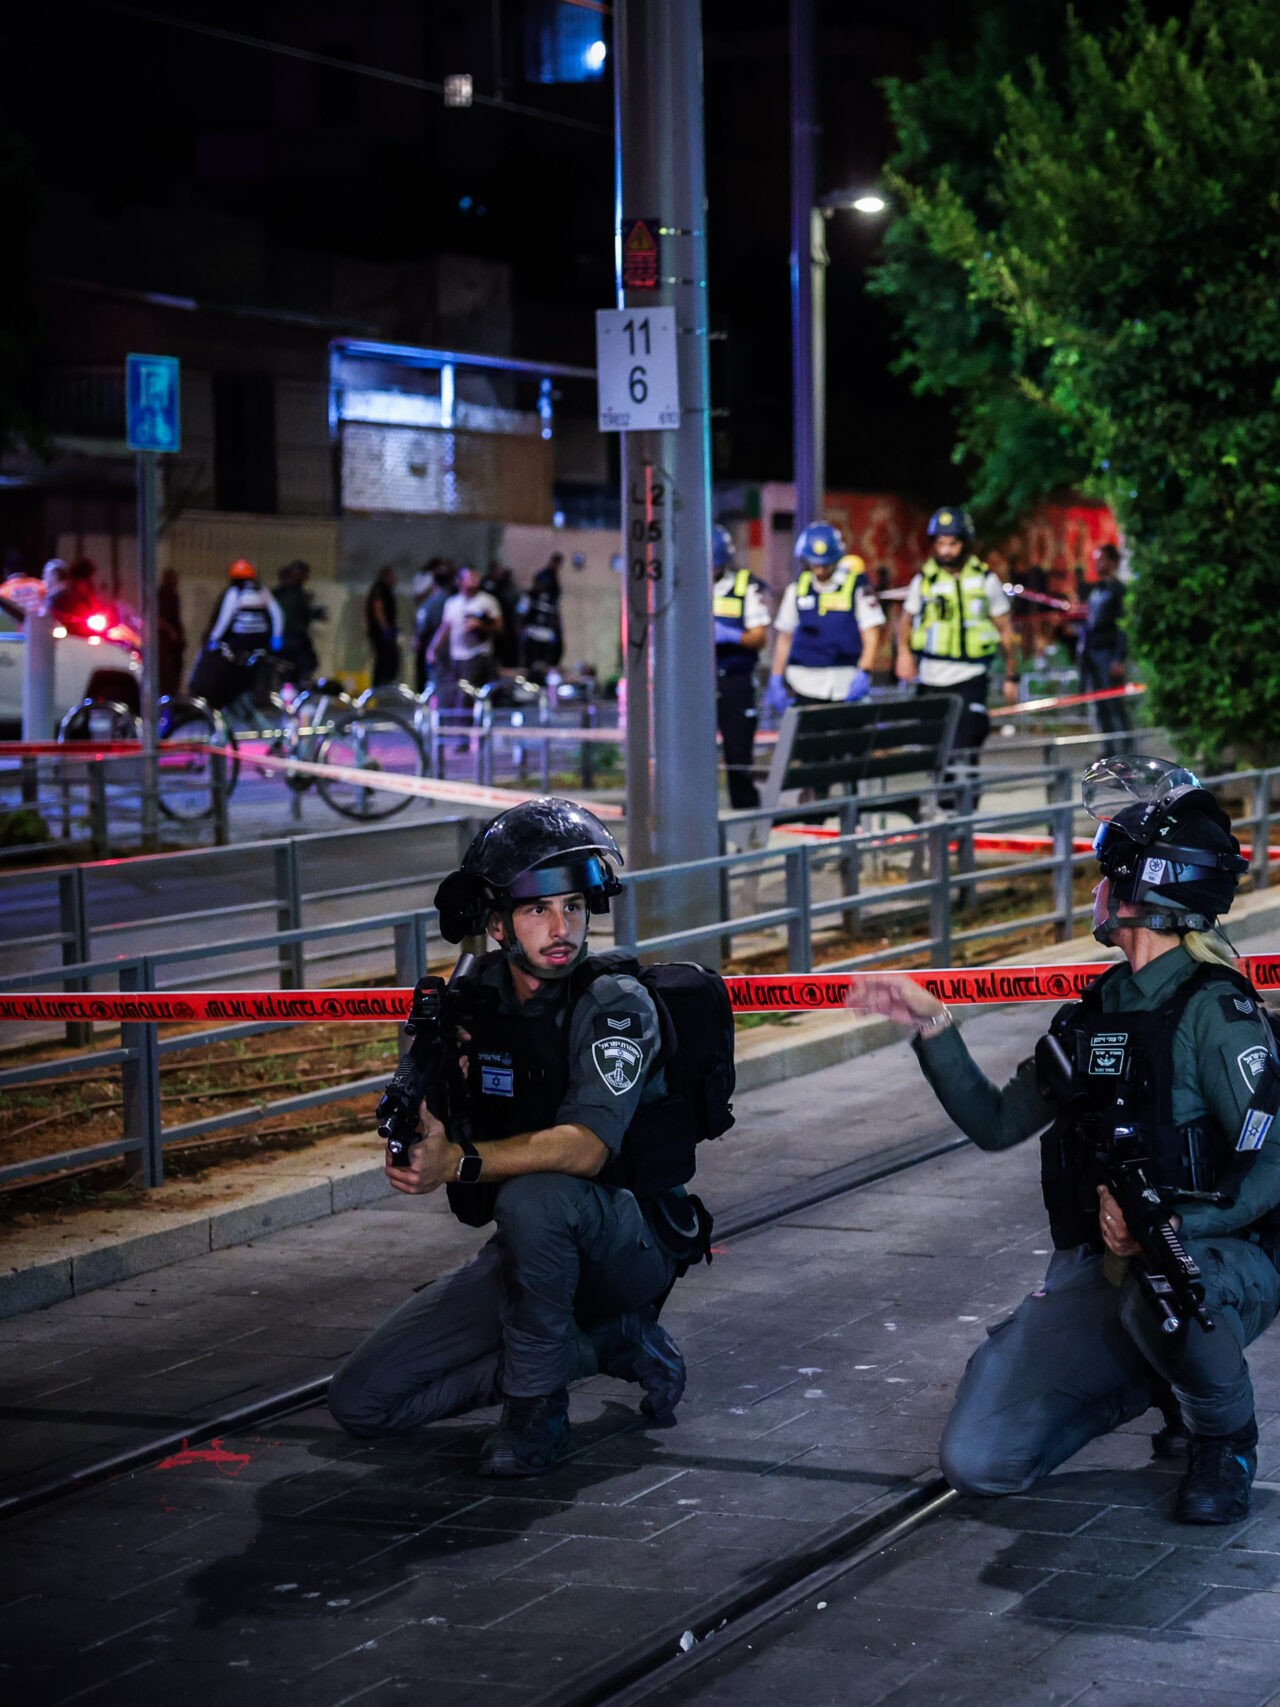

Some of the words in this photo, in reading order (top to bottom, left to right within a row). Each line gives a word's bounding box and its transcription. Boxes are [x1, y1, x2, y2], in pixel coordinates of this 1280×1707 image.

[622, 317, 652, 357] 11
[629, 366, 649, 404] 6
[632, 520, 662, 542] 05
[631, 559, 662, 581] 03
[755, 985, 801, 1006] מעבר
[925, 979, 975, 1003] שראל
[974, 973, 998, 998] אין
[999, 977, 1047, 998] מעבר
